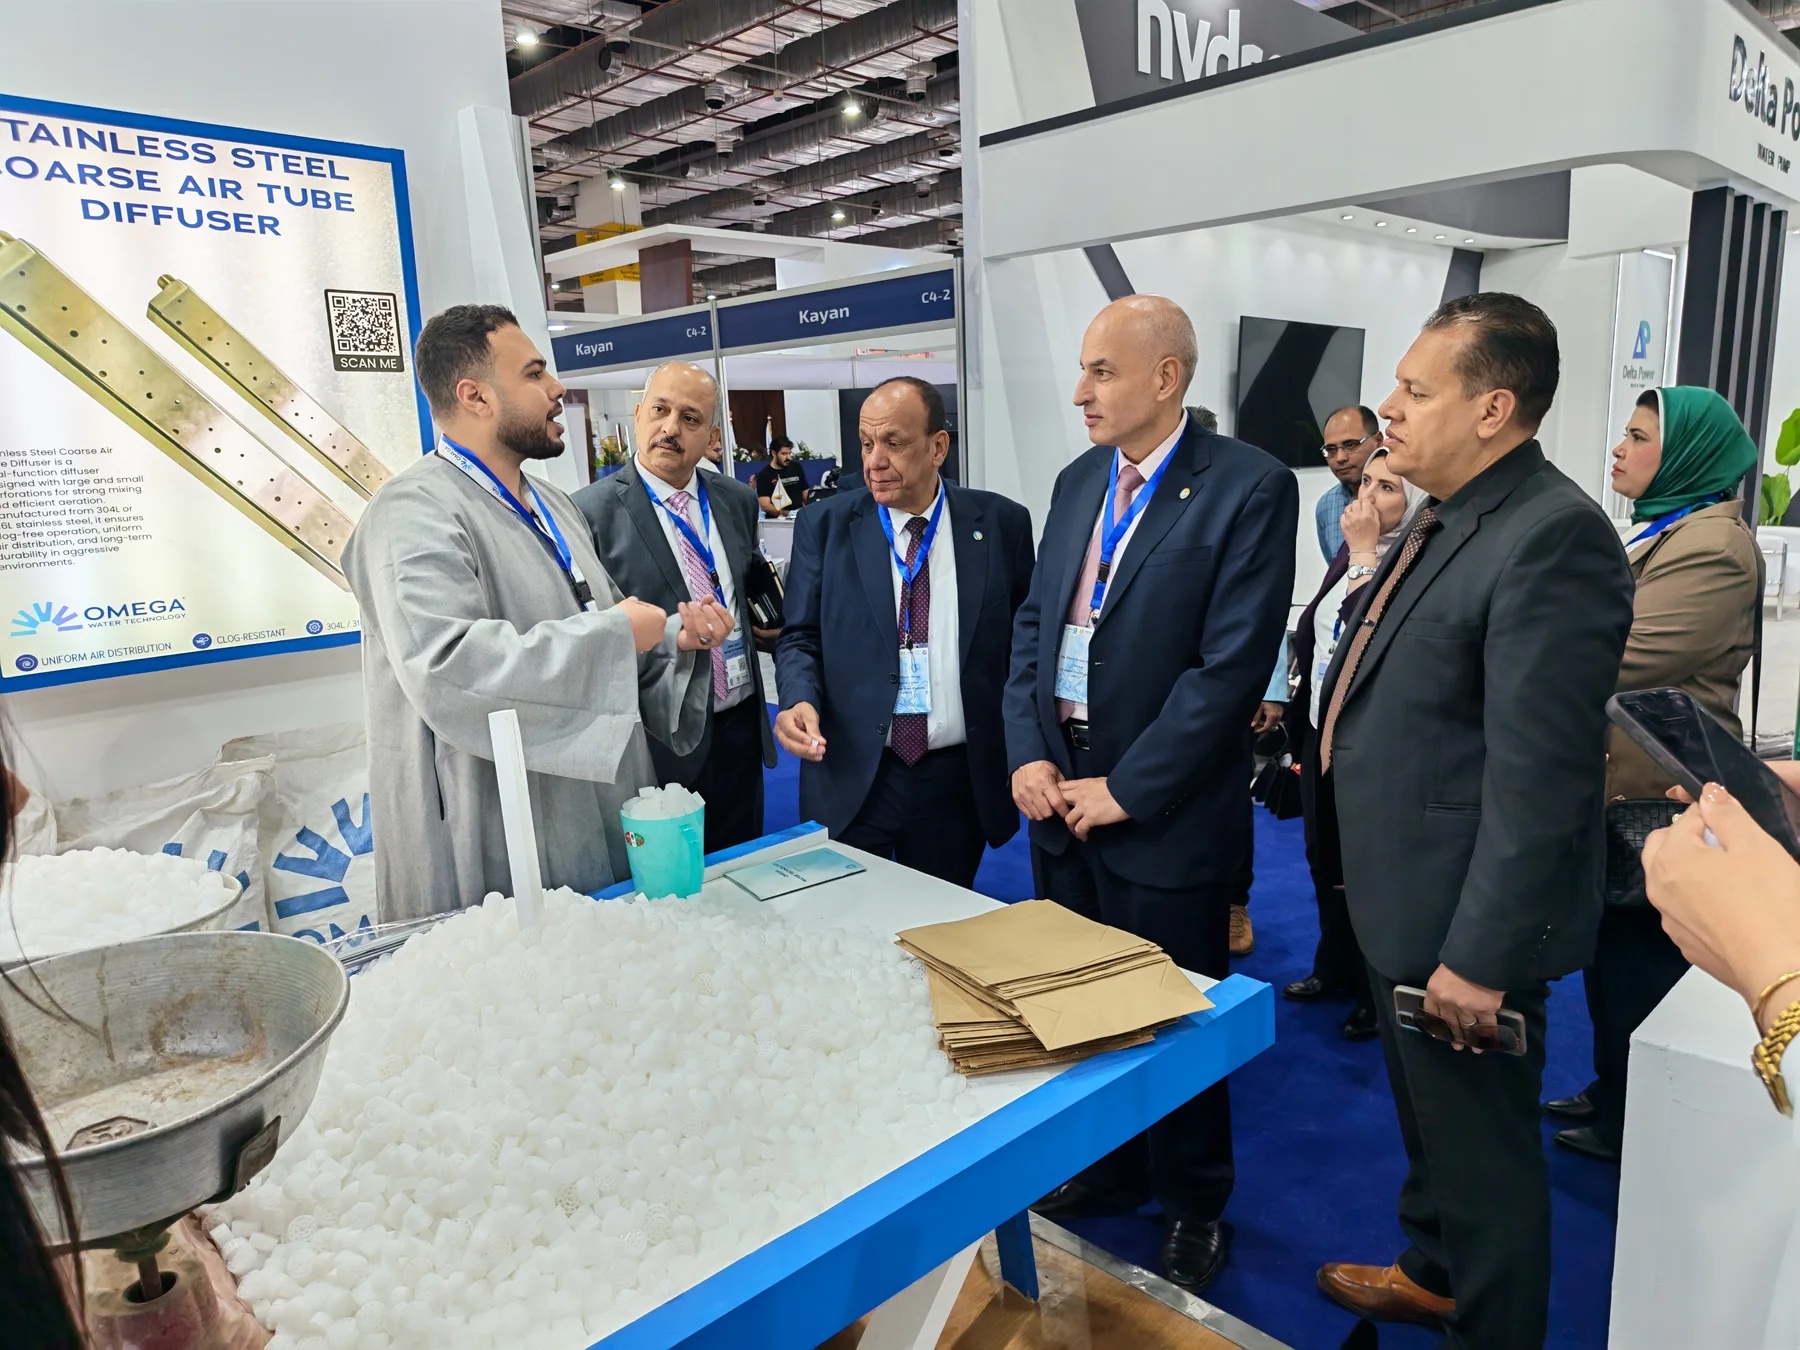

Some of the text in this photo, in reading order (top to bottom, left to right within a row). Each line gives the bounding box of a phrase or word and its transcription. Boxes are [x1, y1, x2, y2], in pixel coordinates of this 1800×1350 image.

[1729, 33, 1778, 128] Delta
[231, 147, 350, 181] STEEL
[0, 156, 355, 213] OARSE AIR TUBE
[80, 198, 282, 236] DIFFUSER
[799, 289, 951, 325] Kayan C4-2
[575, 326, 707, 357] Kayan C4-2
[340, 357, 398, 369] SCAN ME
[1623, 364, 1637, 379] Delta
[30, 448, 56, 456] Steel
[59, 448, 98, 456] Coarse
[10, 458, 51, 468] Diffuser
[54, 458, 63, 466] is
[60, 467, 99, 475] diffuser
[38, 479, 60, 487] with
[63, 477, 90, 487] large
[93, 477, 114, 485] and
[116, 475, 144, 483] small
[55, 488, 69, 496] for
[72, 487, 106, 496] strong
[108, 486, 142, 494] mixing
[12, 499, 56, 508] efficient
[58, 497, 106, 506] aeration.
[69, 507, 94, 515] from
[96, 506, 120, 514] 304L
[16, 519, 63, 529] stainless
[66, 517, 93, 526] steel,
[95, 516, 102, 524] it
[104, 515, 144, 523] ensures
[47, 528, 100, 538] operation,
[102, 525, 142, 533] uniform
[12, 539, 75, 549] distribution,
[77, 537, 98, 545] and
[100, 533, 152, 544] long-term
[51, 548, 60, 557] in
[63, 545, 119, 557] aggressive
[84, 599, 186, 621] OMEGA
[88, 613, 187, 629] WATER TECHNOLOGY
[326, 621, 345, 630] 304L
[217, 628, 286, 644] CLOG-RESISTANT
[41, 642, 172, 666] UNIFORM AIR DISTRIBUTION
